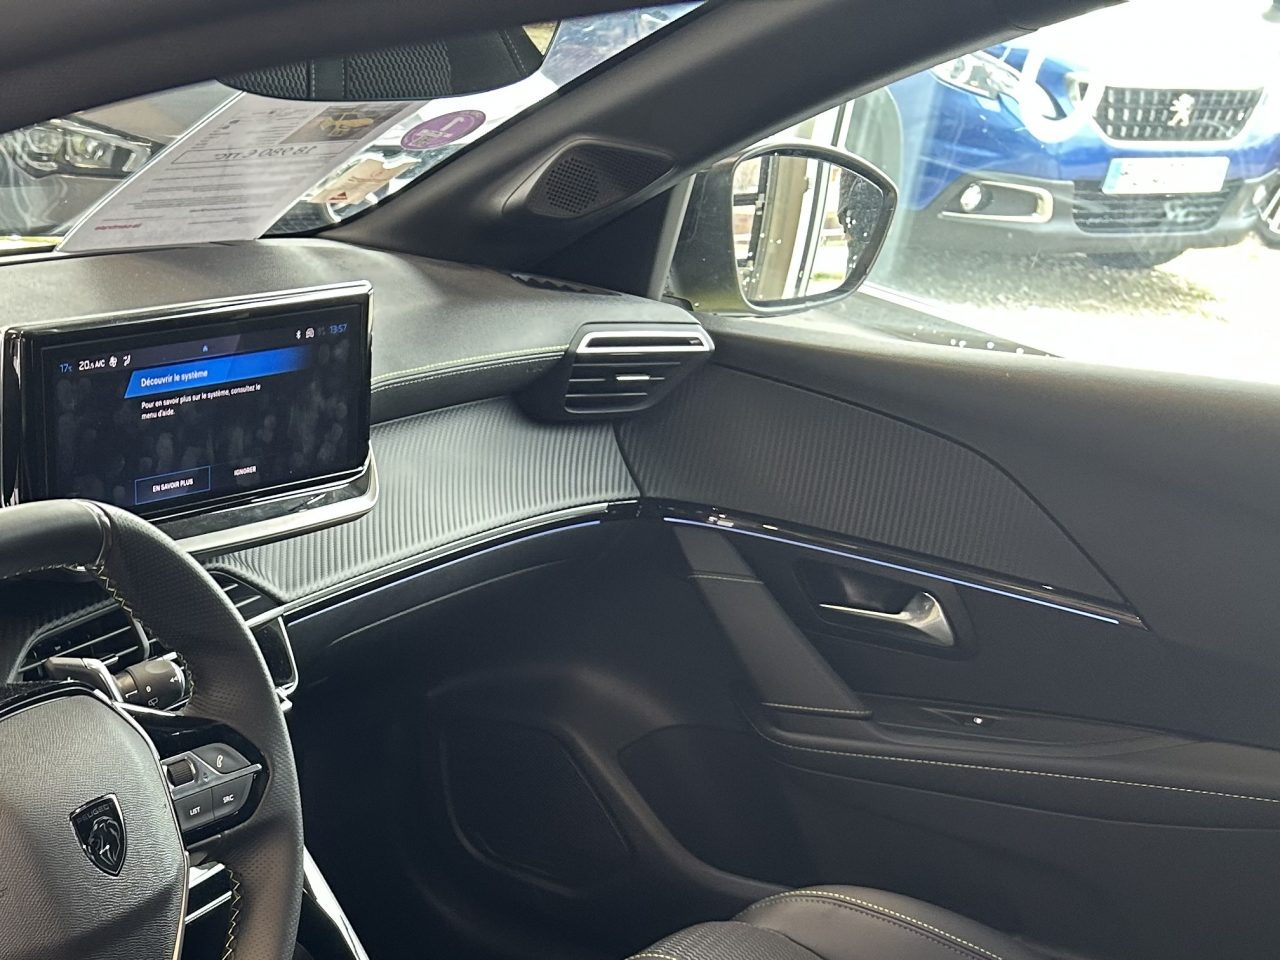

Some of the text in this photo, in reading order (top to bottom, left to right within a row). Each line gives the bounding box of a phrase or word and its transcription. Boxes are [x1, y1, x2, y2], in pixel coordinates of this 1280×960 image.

[141, 370, 208, 387] Découvrir le système
[141, 400, 154, 409] Pour
[155, 399, 163, 407] en
[163, 397, 179, 406] savoir
[179, 395, 192, 405] plus
[192, 393, 201, 401] sur
[207, 389, 231, 400] système,
[231, 385, 256, 394] consultez
[255, 383, 262, 391] le
[141, 408, 176, 420] menu d'aide.
[233, 465, 257, 476] IGNORER
[152, 478, 194, 493] EN SAVOIR PLUS
